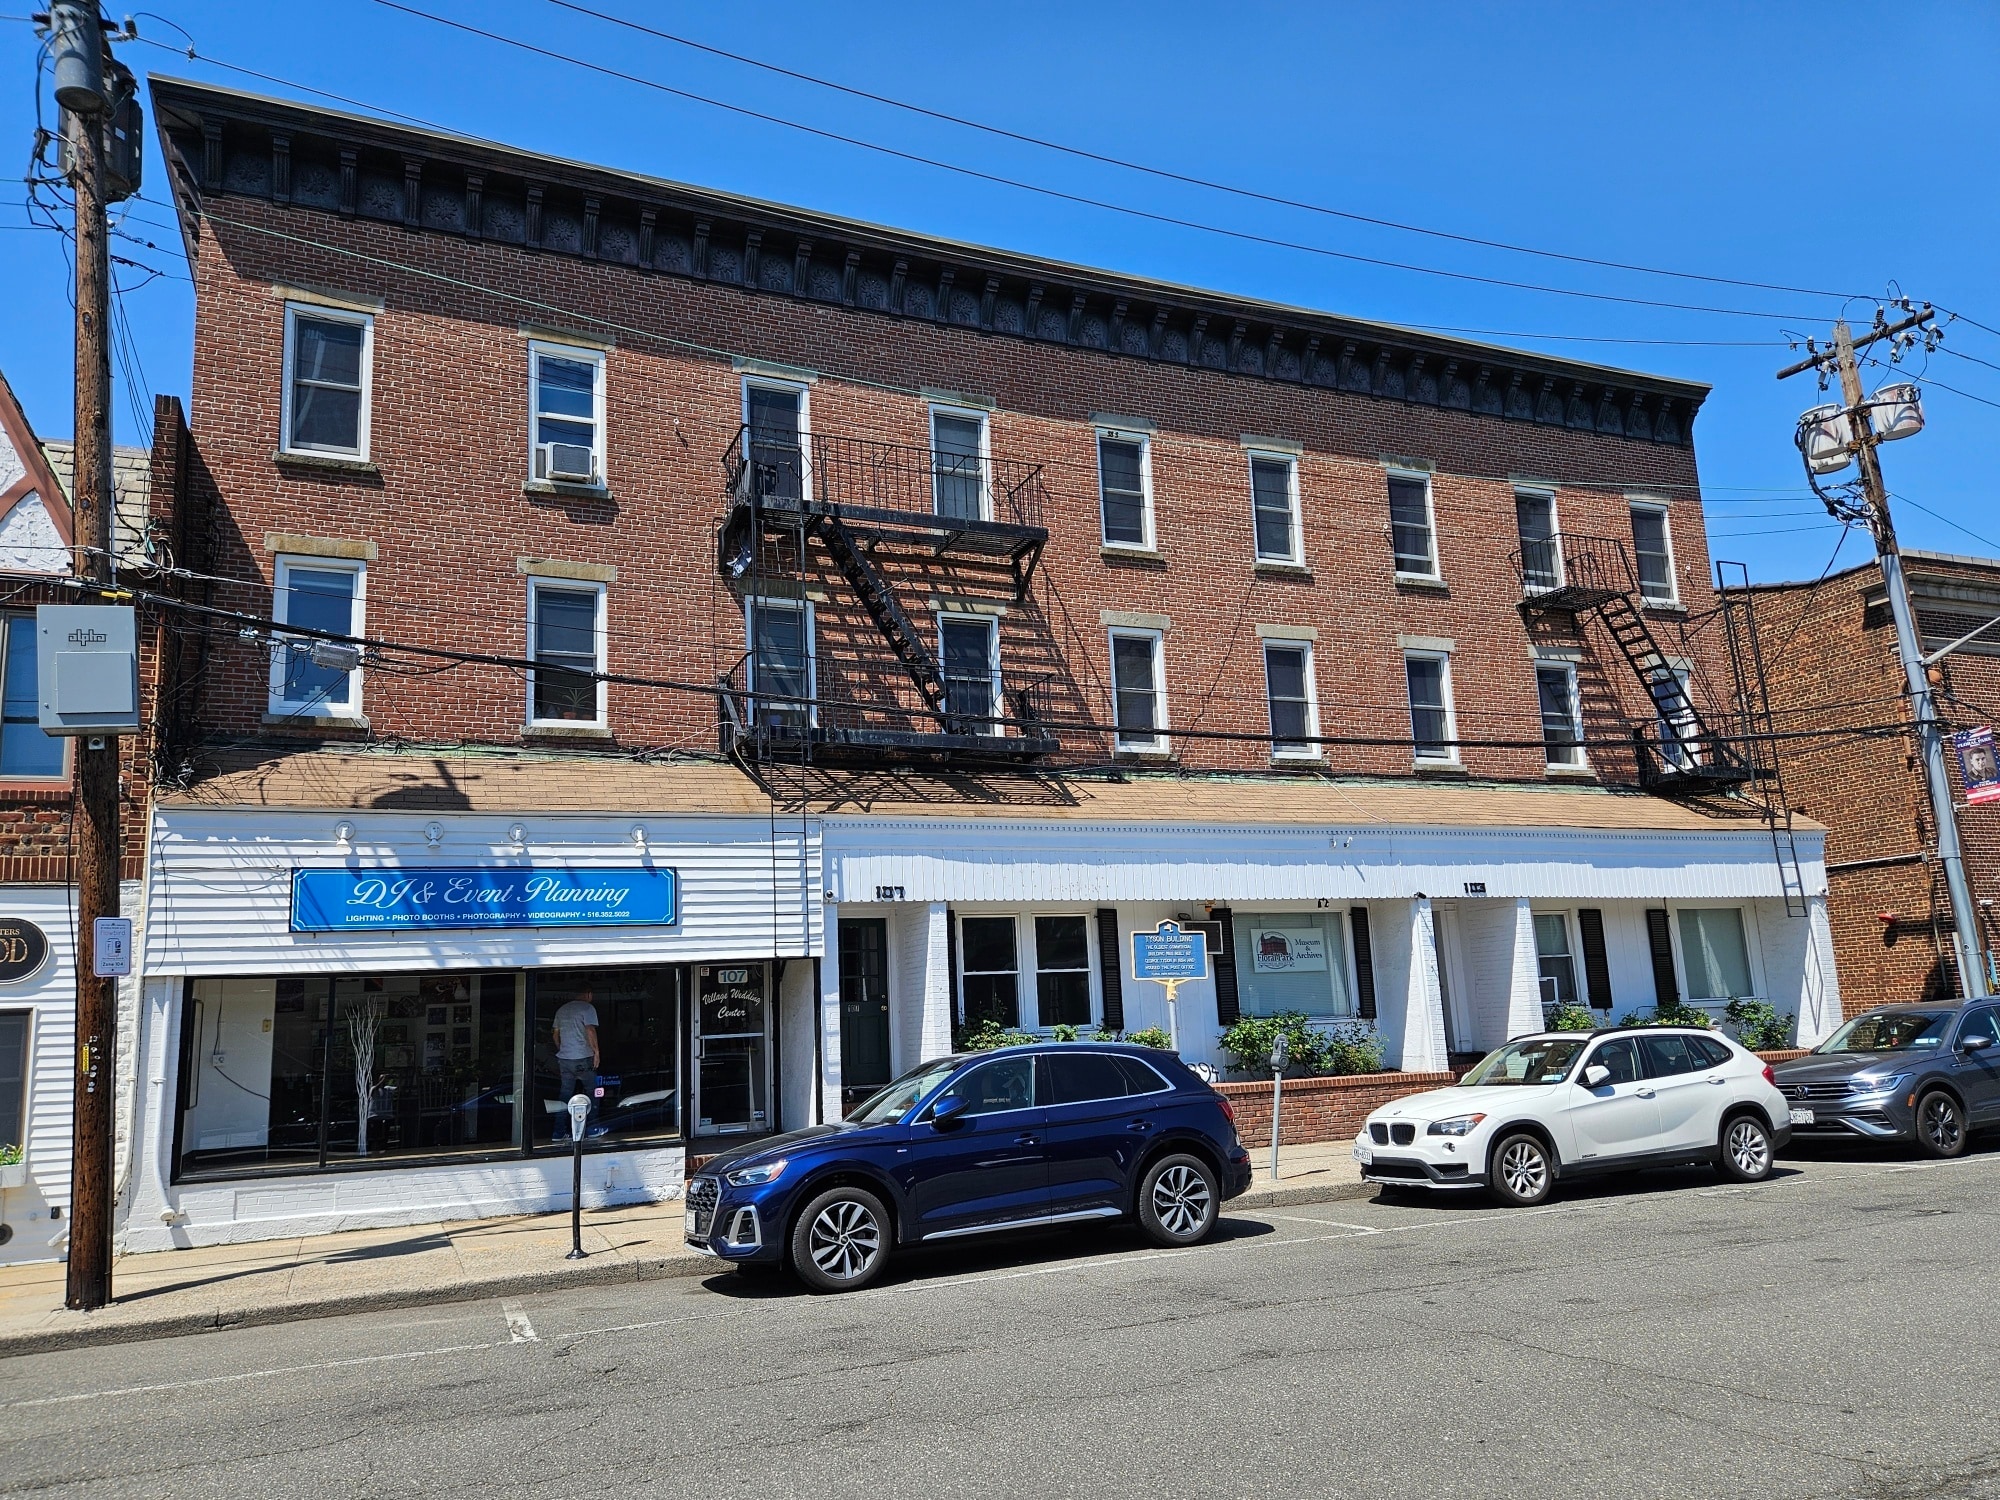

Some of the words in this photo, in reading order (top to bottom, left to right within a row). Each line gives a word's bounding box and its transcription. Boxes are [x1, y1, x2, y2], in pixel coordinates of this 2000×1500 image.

[68, 628, 107, 647] alpha
[346, 878, 418, 909] DJ
[412, 881, 438, 904] &
[443, 877, 515, 904] Event
[517, 876, 630, 908] Planning
[875, 885, 905, 899] 107
[462, 912, 521, 920] PHOTOGRAPHY
[527, 911, 580, 919] VIDEOGRAPHY
[1144, 935, 1164, 943] TYSON
[1166, 935, 1193, 943] BUILDING
[1294, 938, 1321, 946] Museum
[1257, 953, 1277, 962] Floral
[1277, 952, 1295, 962] Park
[720, 970, 746, 983] 107
[702, 991, 729, 1005] Village
[730, 988, 761, 1007] Wedding
[717, 1006, 747, 1019] Center
